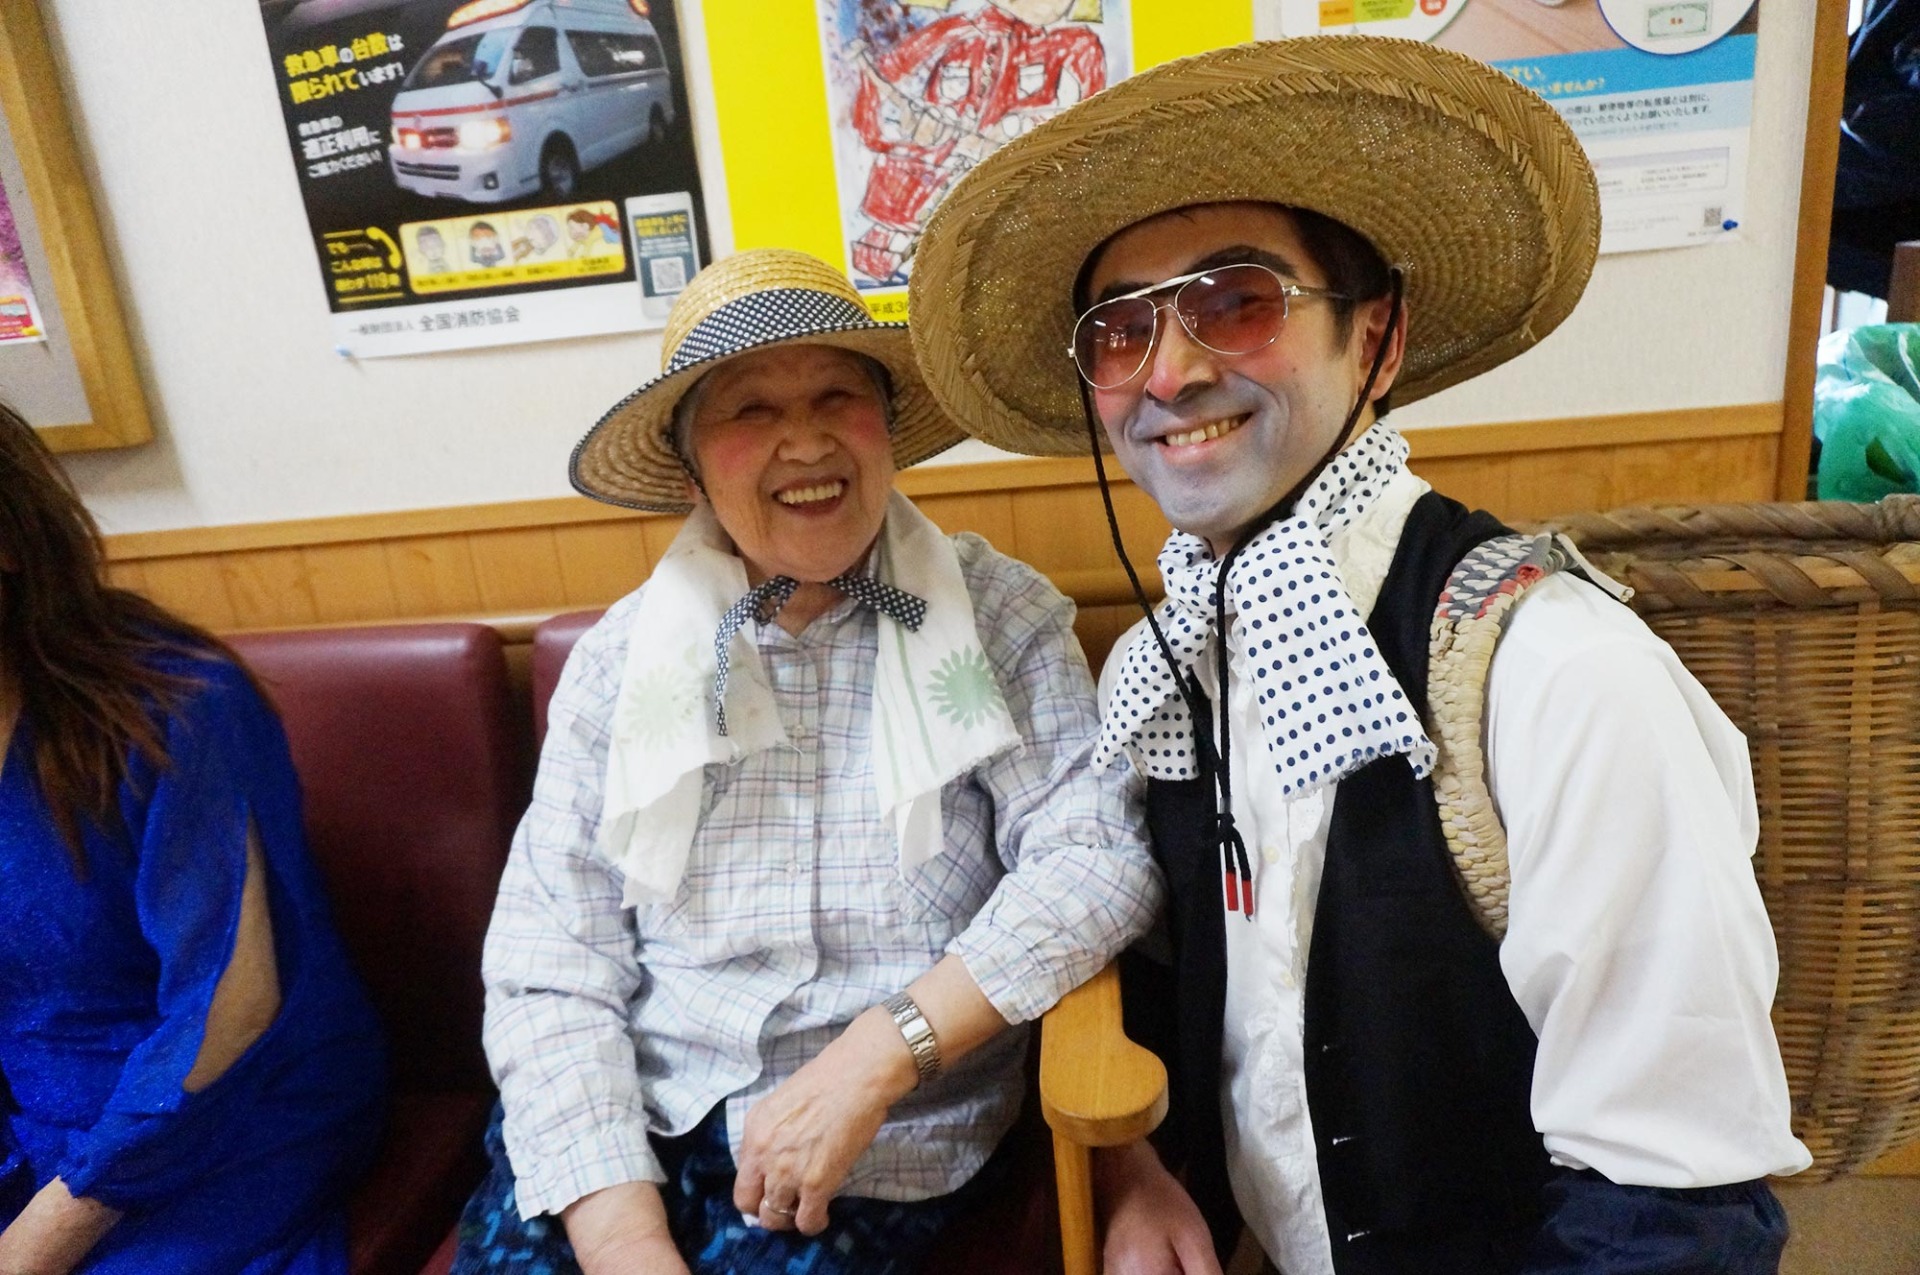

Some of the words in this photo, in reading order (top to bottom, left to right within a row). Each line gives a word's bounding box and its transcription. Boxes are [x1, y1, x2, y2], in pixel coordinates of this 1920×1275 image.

[283, 31, 406, 78] 救急車の台数は
[301, 125, 382, 159] 適正利用に
[419, 305, 520, 332] 全国消防協会
